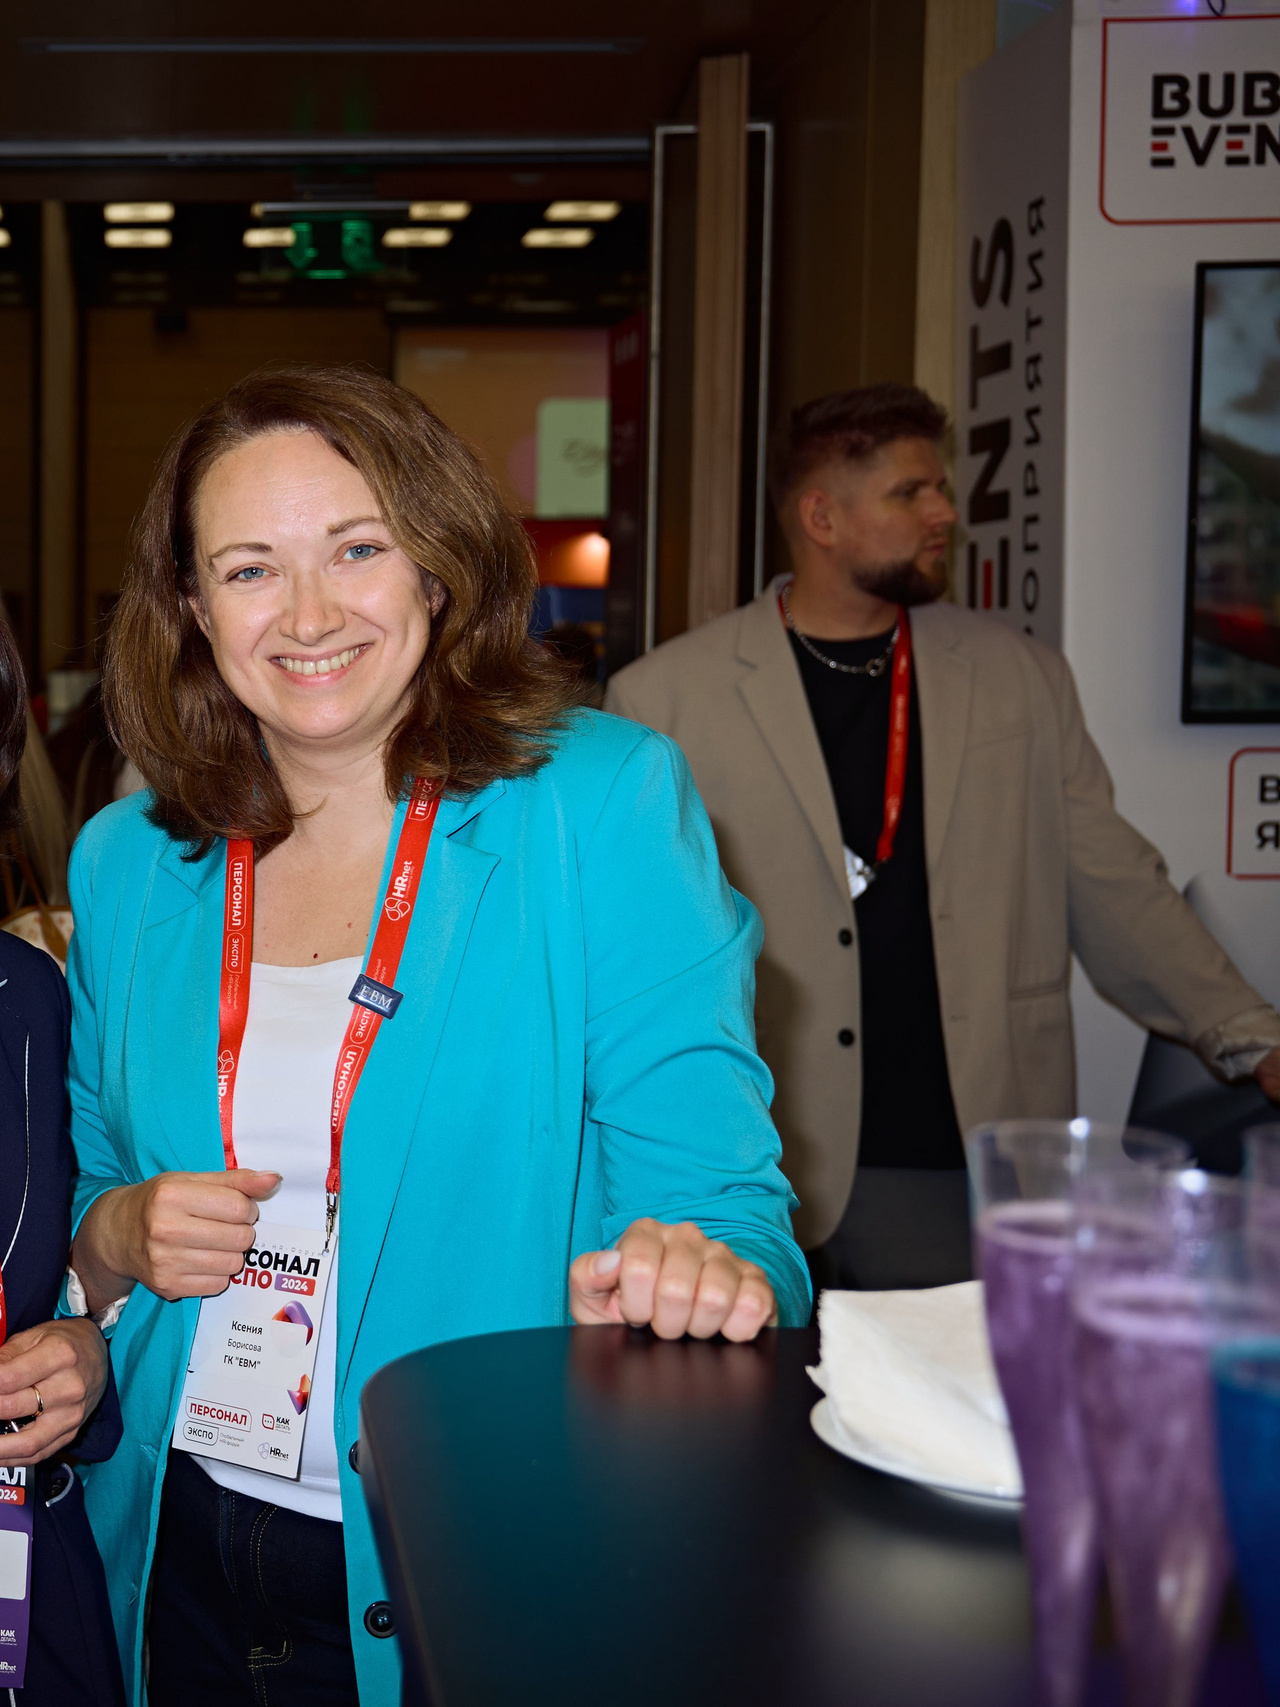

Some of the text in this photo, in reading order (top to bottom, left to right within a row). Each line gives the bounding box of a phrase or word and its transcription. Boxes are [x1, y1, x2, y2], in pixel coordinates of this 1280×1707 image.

[1152, 71, 1280, 117] BUB
[968, 216, 1016, 609] ENTS
[1022, 194, 1045, 634] ОПРИЯТИЯ
[392, 860, 413, 898] HRnet
[231, 862, 243, 926] ПЕРСОНАЛ
[231, 938, 239, 968] ЭКСПО
[331, 1051, 357, 1127] ПЕРСОНАЛ
[243, 1248, 320, 1277] СОНАЛ
[281, 1278, 308, 1292] 2024
[231, 1320, 263, 1335] Ксения
[227, 1338, 262, 1352] Борисова
[223, 1355, 234, 1365] ГК
[189, 1402, 248, 1426] ПЕРСОНАЛ
[276, 1416, 291, 1425] КАК
[187, 1426, 214, 1440] ЭКСПО
[269, 1446, 289, 1460] HRnet
[0, 1629, 15, 1637] КАК
